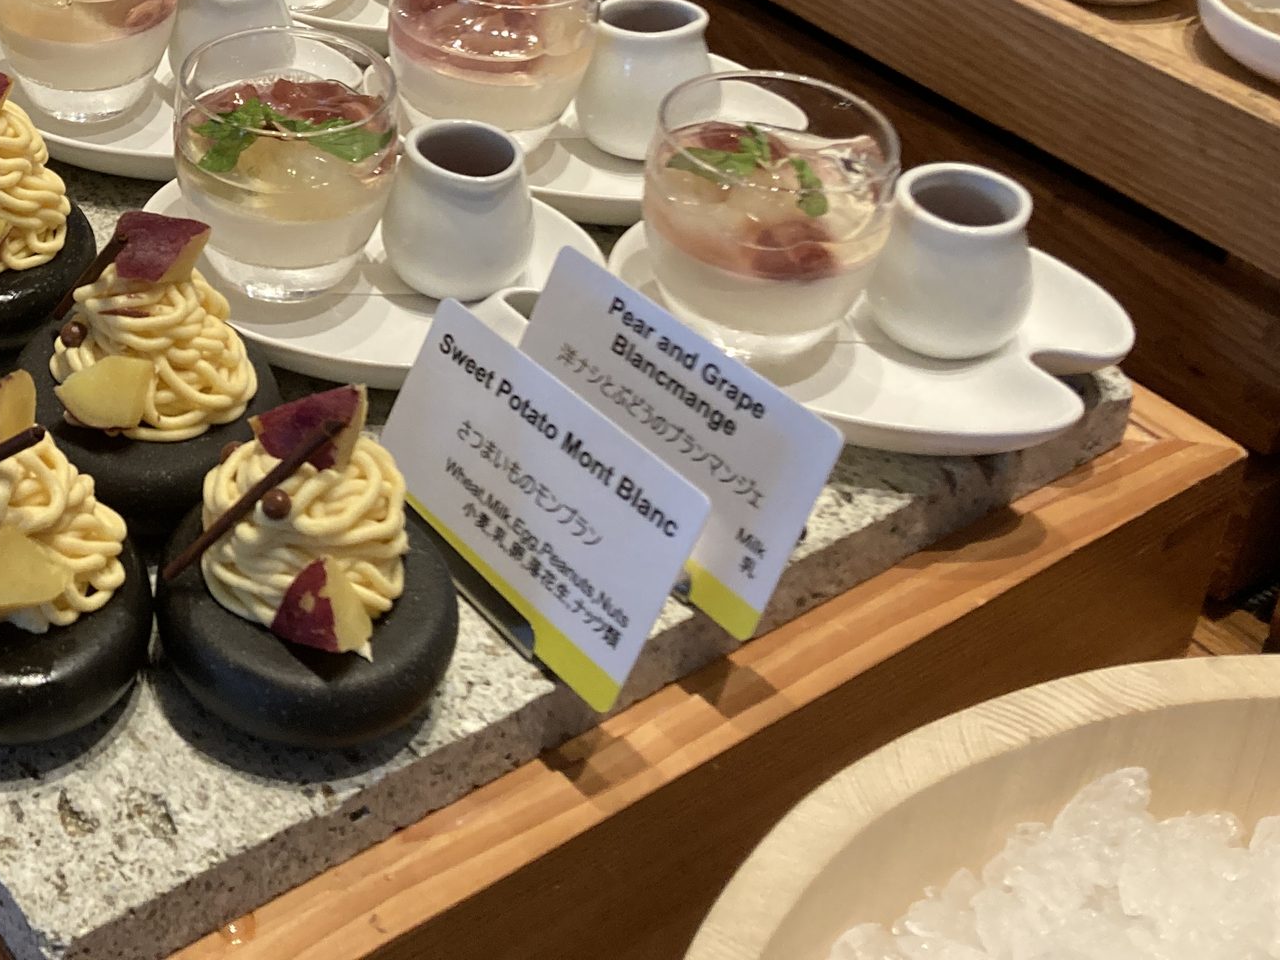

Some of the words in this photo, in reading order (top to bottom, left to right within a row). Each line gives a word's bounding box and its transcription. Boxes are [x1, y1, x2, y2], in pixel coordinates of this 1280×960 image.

[608, 296, 656, 339] Pear
[657, 336, 699, 371] and
[701, 363, 765, 419] Grape
[611, 334, 736, 436] Blancmange
[439, 333, 495, 389] Sweet
[495, 378, 558, 440] Potato
[561, 431, 614, 486] Mont
[615, 476, 678, 537] Blanc
[457, 420, 602, 546] さつまいものモンブラン
[735, 526, 767, 560] Milk
[739, 555, 756, 579] 乳
